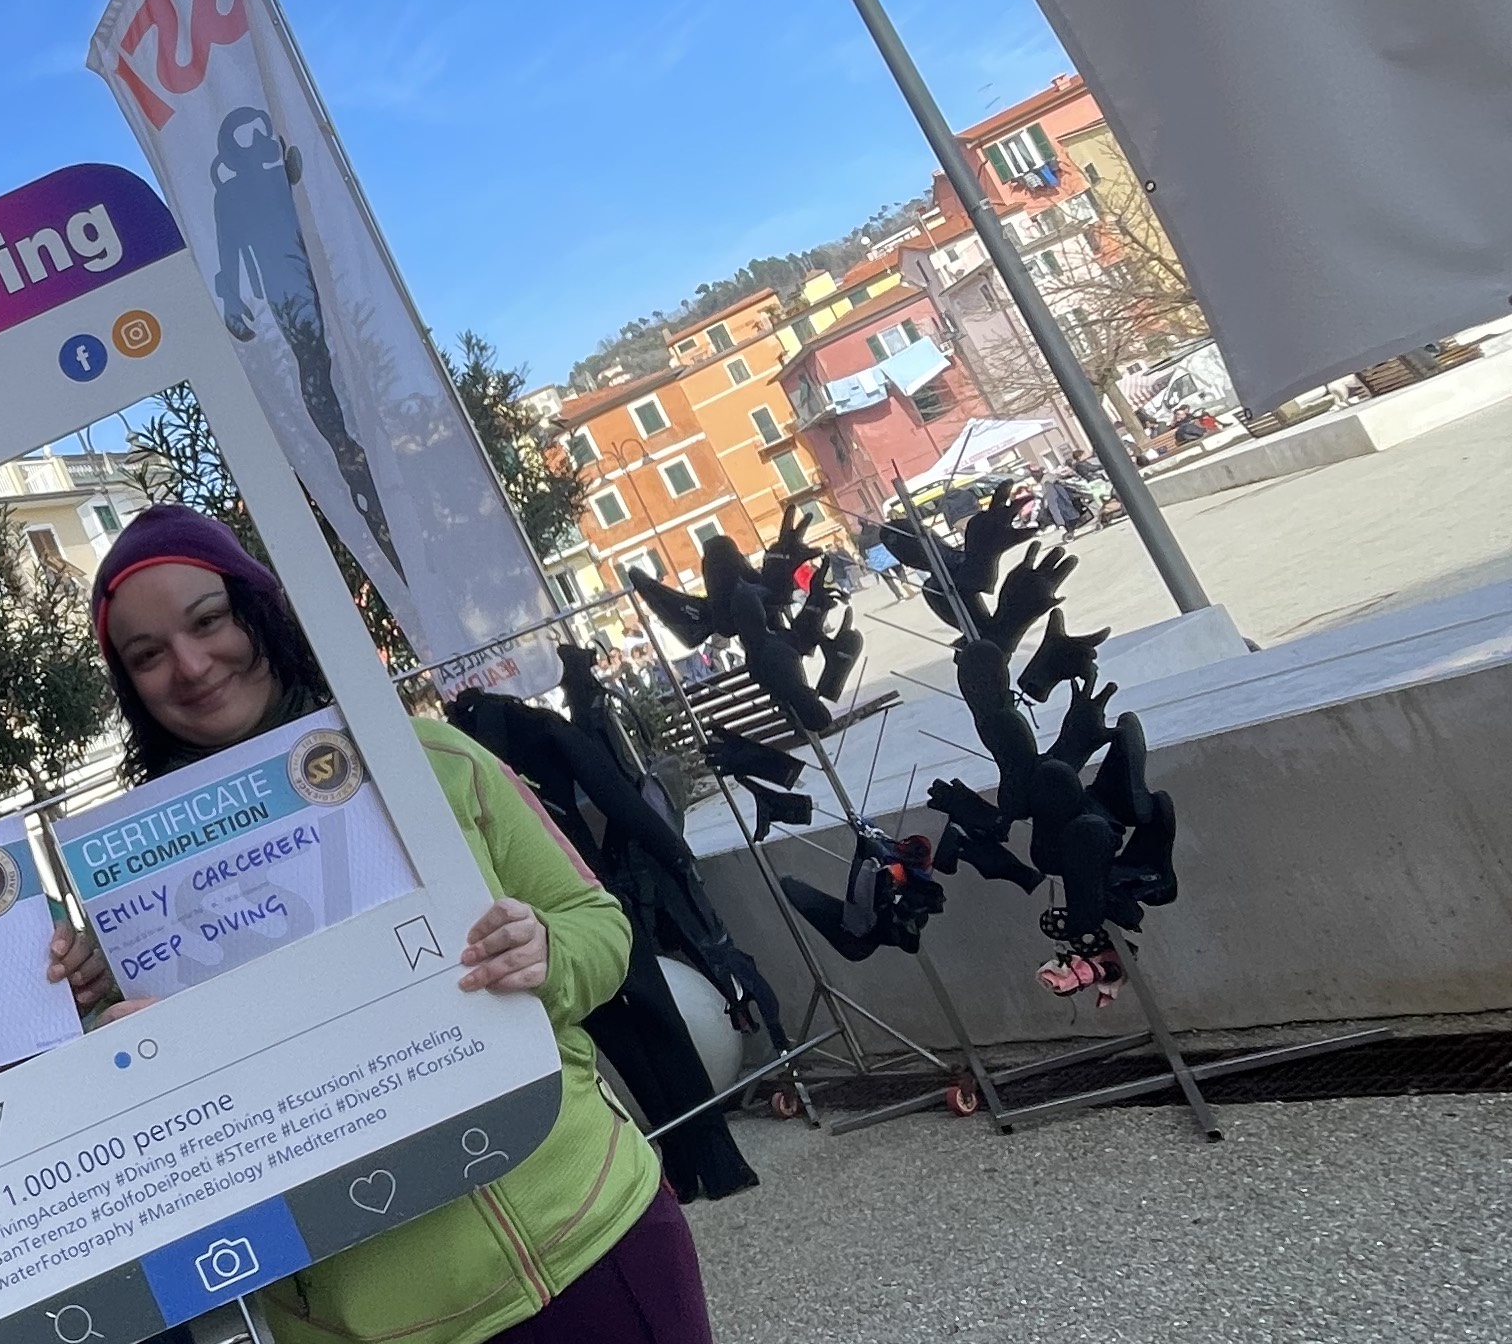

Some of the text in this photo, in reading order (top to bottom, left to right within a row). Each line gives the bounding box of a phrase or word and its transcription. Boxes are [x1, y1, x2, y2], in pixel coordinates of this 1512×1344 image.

[82, 768, 273, 868] CERTIFICATE
[92, 801, 269, 888] OF COMPLETION
[96, 885, 168, 934] EMILY
[192, 825, 321, 890] CARCERERI
[121, 934, 182, 981] DEEP
[200, 895, 288, 942] DIVING
[2, 1137, 126, 1207] 1.000.000
[133, 1094, 235, 1155] persone
[90, 1158, 213, 1223] #GolfoDeiPoeti
[216, 1131, 278, 1166] #5Terre
[281, 1106, 333, 1137] #Lerici
[336, 1074, 404, 1113] #DiveSSI
[407, 1038, 485, 1083] #CorsiSub
[115, 1151, 177, 1188] #Diving
[180, 1108, 275, 1157] #FreeDiving
[277, 1065, 365, 1114] #Escursioni
[367, 1024, 463, 1074] #Snorkeling
[139, 1160, 264, 1226] #MarineBiology
[268, 1107, 388, 1168] #Mediterraneo
